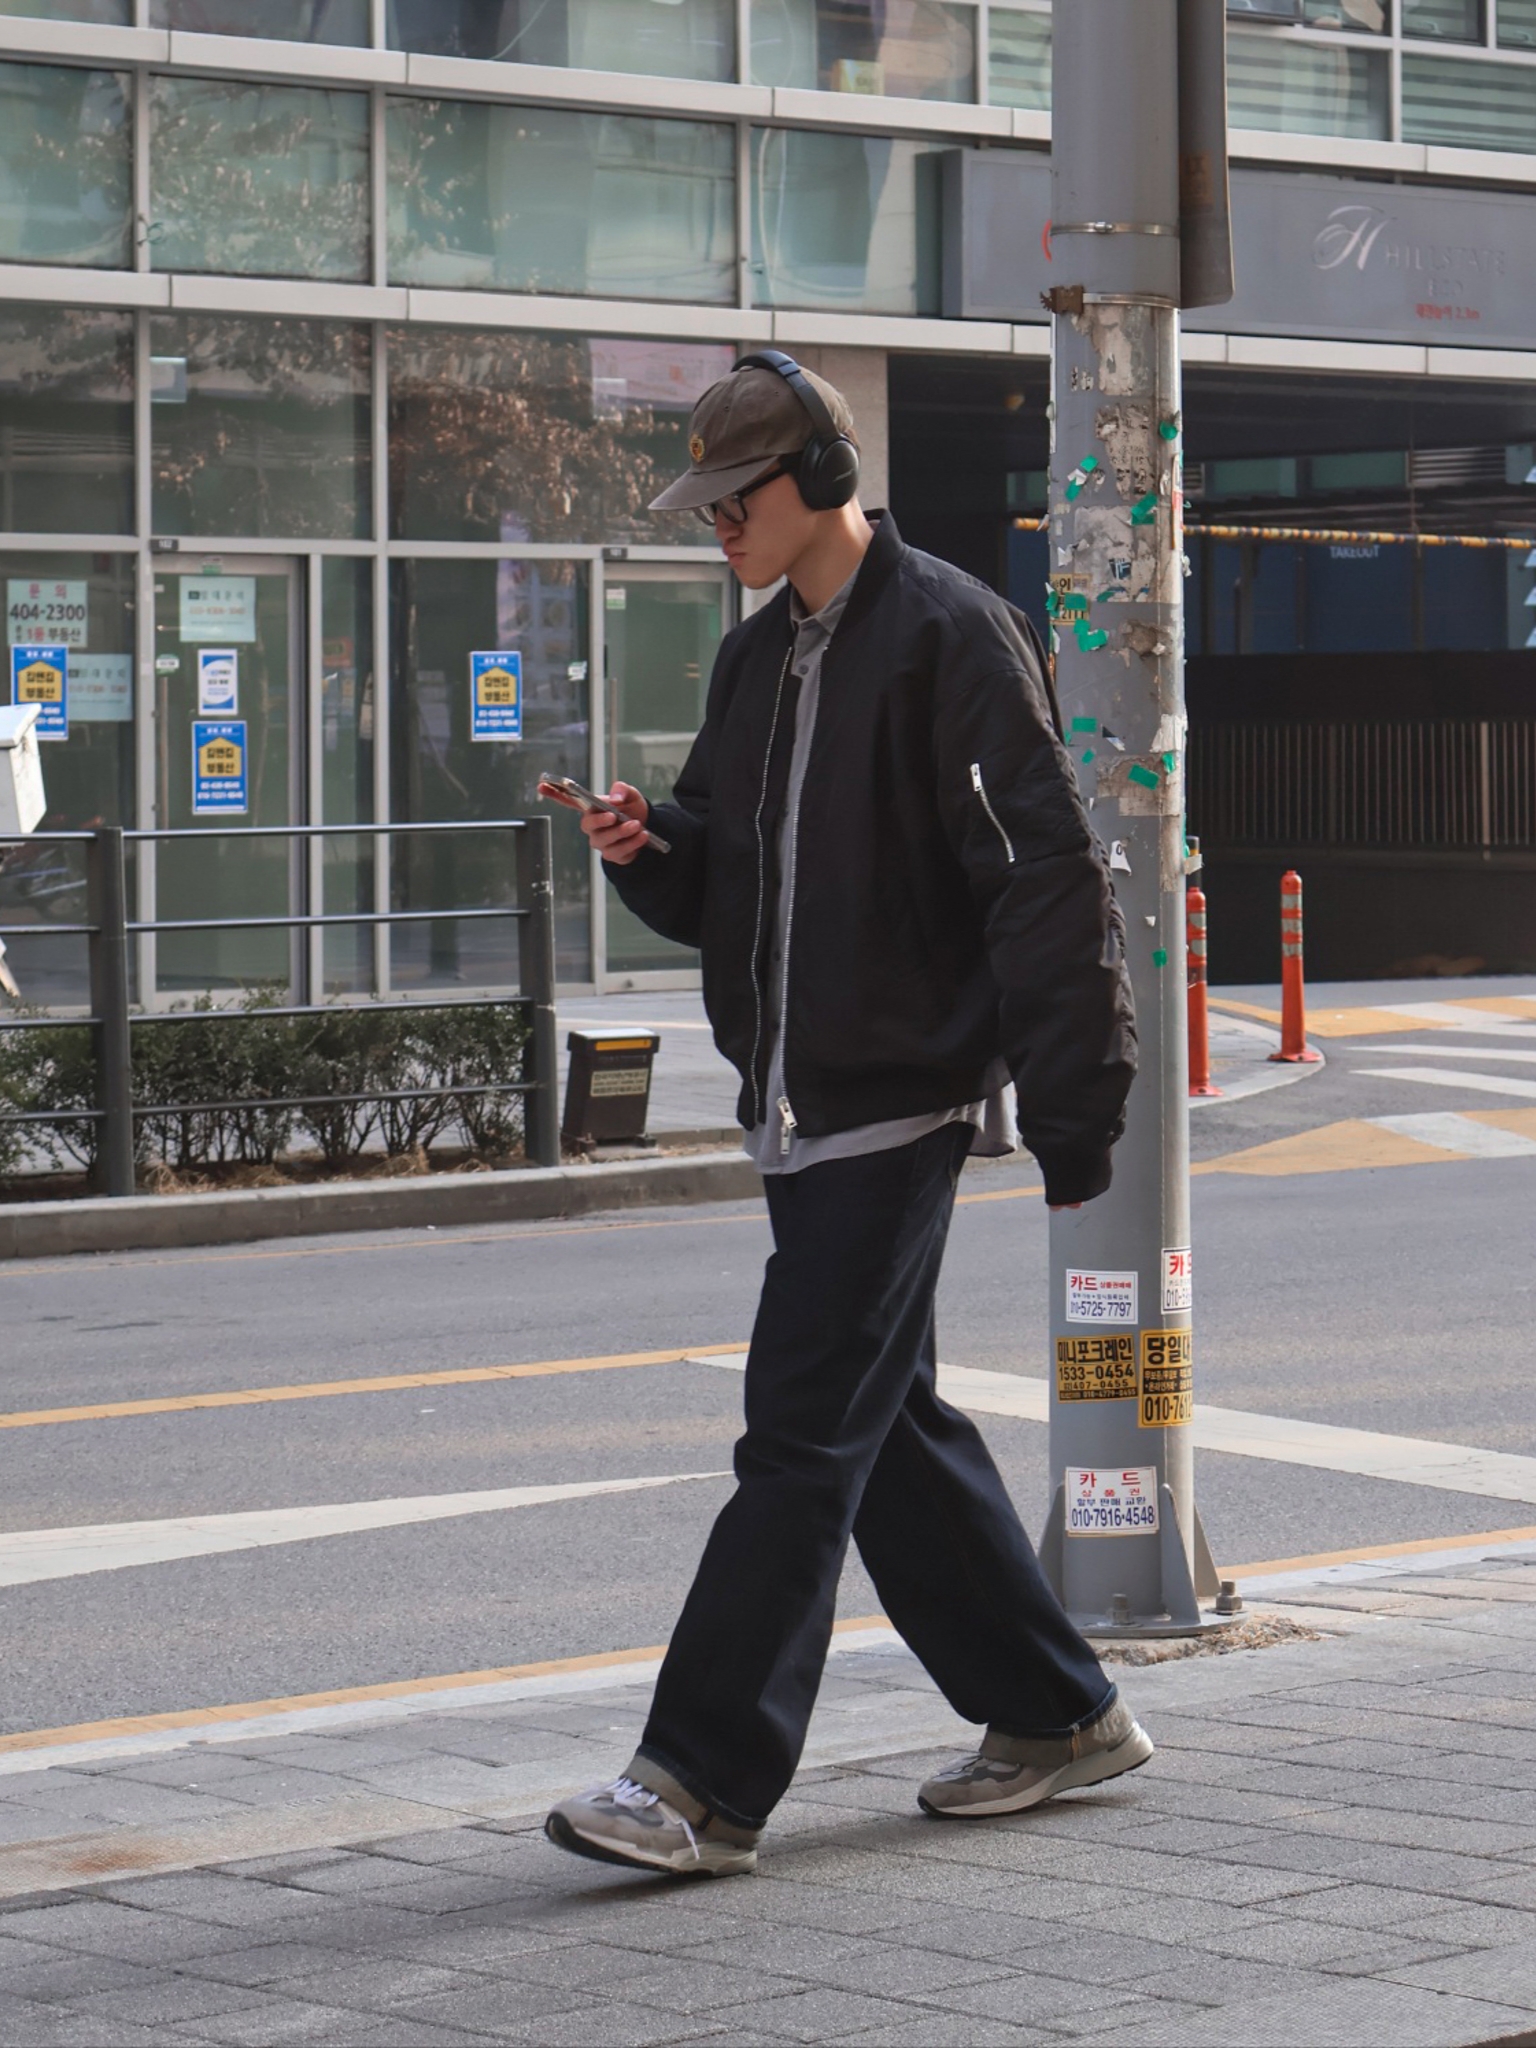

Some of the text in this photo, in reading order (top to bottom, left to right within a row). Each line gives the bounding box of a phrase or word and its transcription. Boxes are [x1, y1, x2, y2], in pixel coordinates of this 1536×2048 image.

[9, 603, 86, 621] 404-2300
[1070, 1274, 1098, 1291] 카드
[1058, 1337, 1133, 1364] 미니포크레인
[1059, 1364, 1134, 1381] 1533-0454
